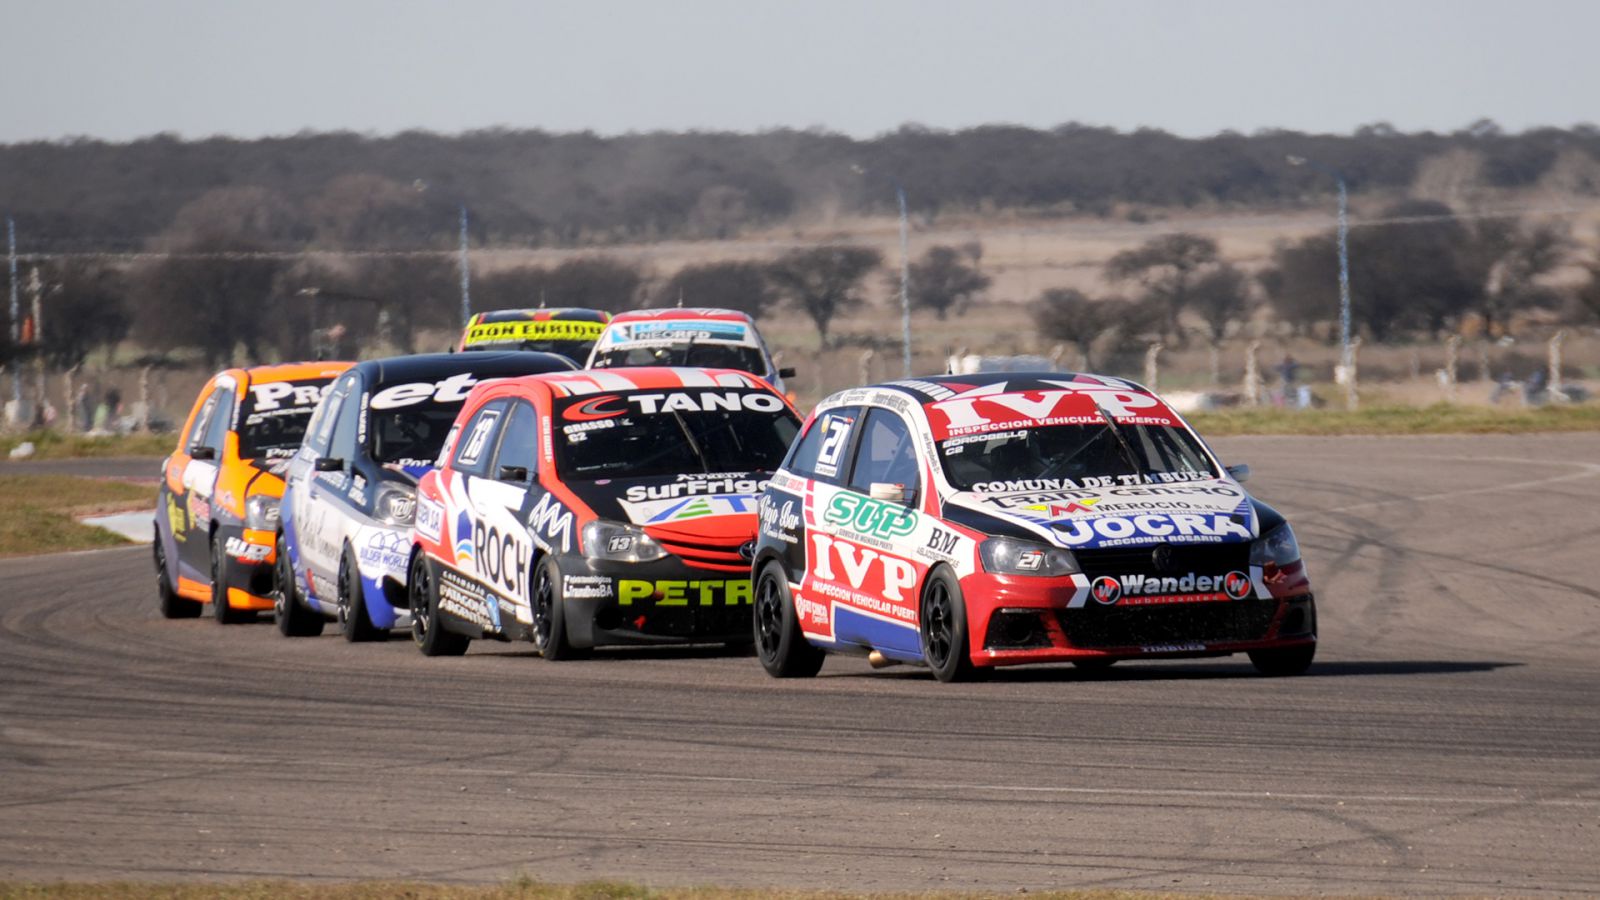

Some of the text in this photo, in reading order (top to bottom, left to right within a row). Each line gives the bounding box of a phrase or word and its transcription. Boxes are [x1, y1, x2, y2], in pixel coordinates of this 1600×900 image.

[931, 390, 1158, 429] IVP
[563, 419, 615, 434] GRASSO
[568, 432, 588, 442] C2
[948, 415, 1171, 437] INSPECCION VEHICULA PUERTO
[971, 476, 1081, 494] COMUNA
[1084, 474, 1115, 489] DE
[1096, 501, 1191, 512] MEROCIO
[1055, 514, 1251, 545] JOCRA
[610, 537, 631, 550] 13
[926, 527, 961, 555] BM
[1098, 535, 1223, 548] SECCIONAL ROSARIO
[811, 533, 917, 602] IVP
[1120, 572, 1224, 595] Wander
[812, 581, 918, 621] INSPECCION VEHICULAR PUERT
